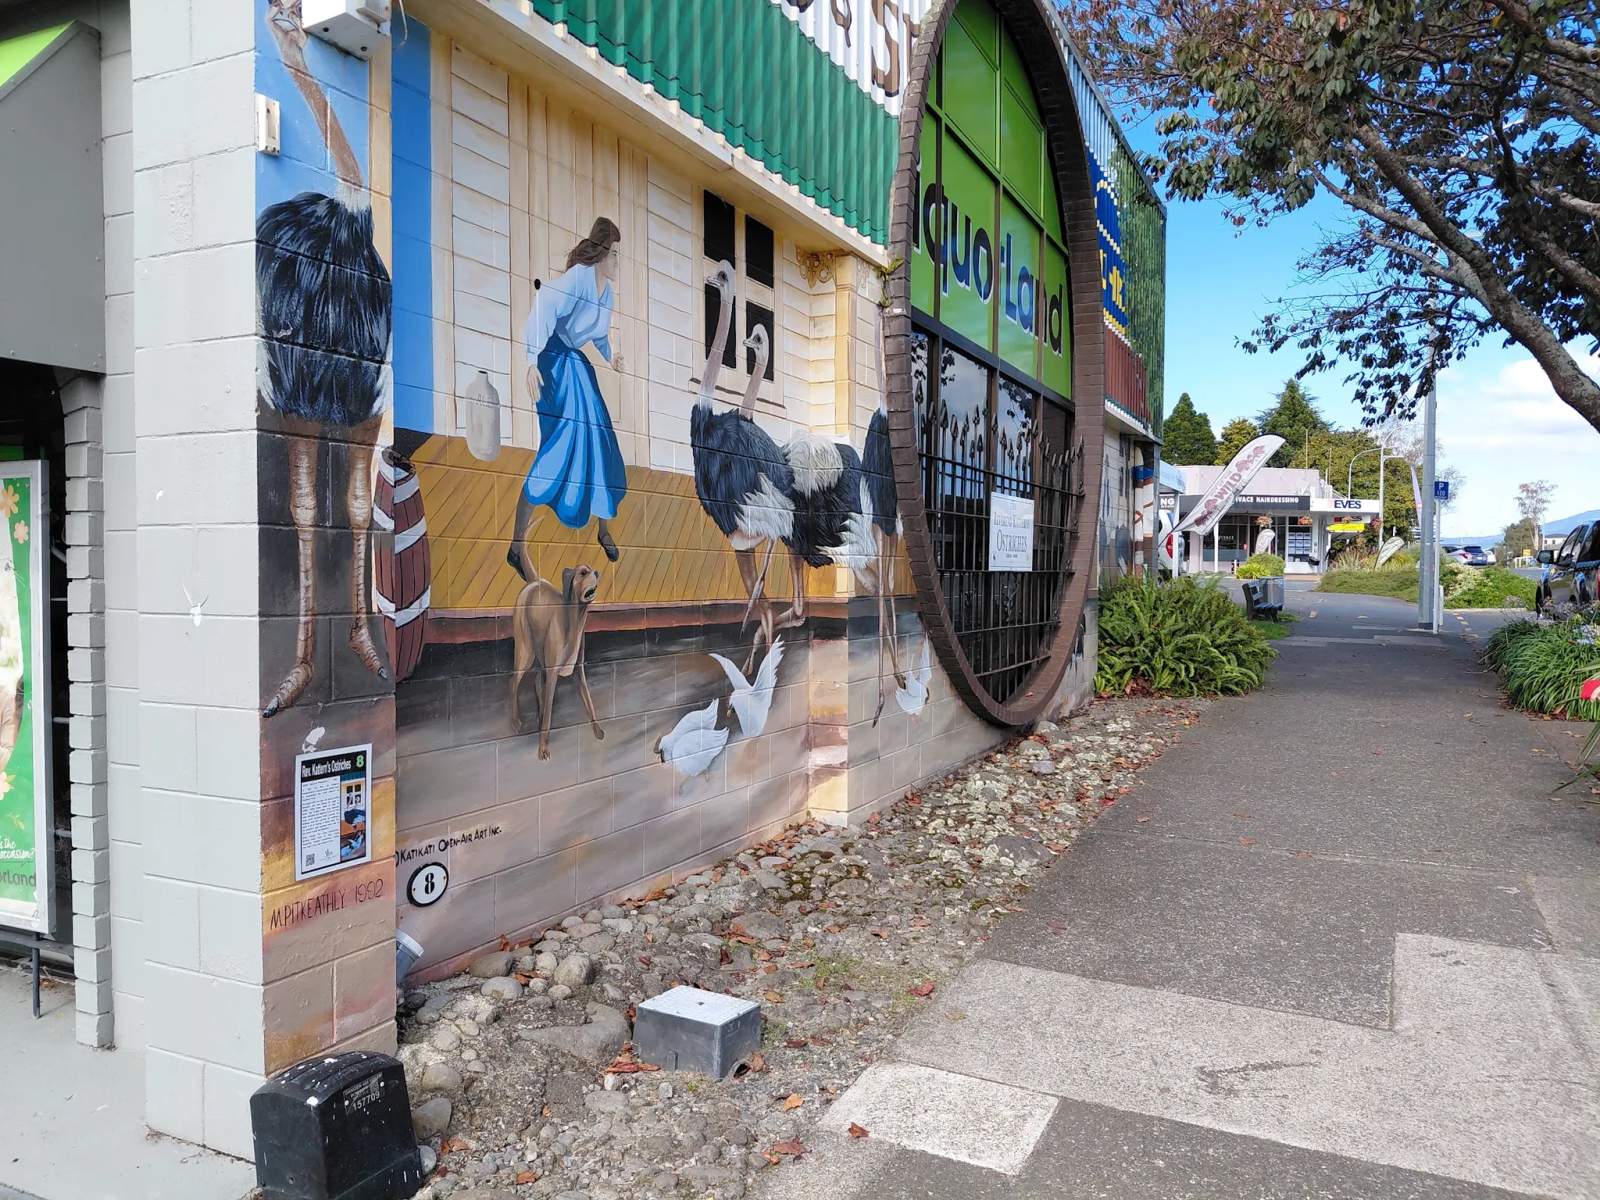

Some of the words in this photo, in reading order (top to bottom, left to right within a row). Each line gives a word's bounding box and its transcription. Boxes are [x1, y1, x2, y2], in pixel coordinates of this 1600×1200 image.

[1334, 500, 1362, 509] EVES
[331, 759, 352, 773] Ostriches
[356, 755, 364, 768] 8
[424, 872, 435, 895] 8
